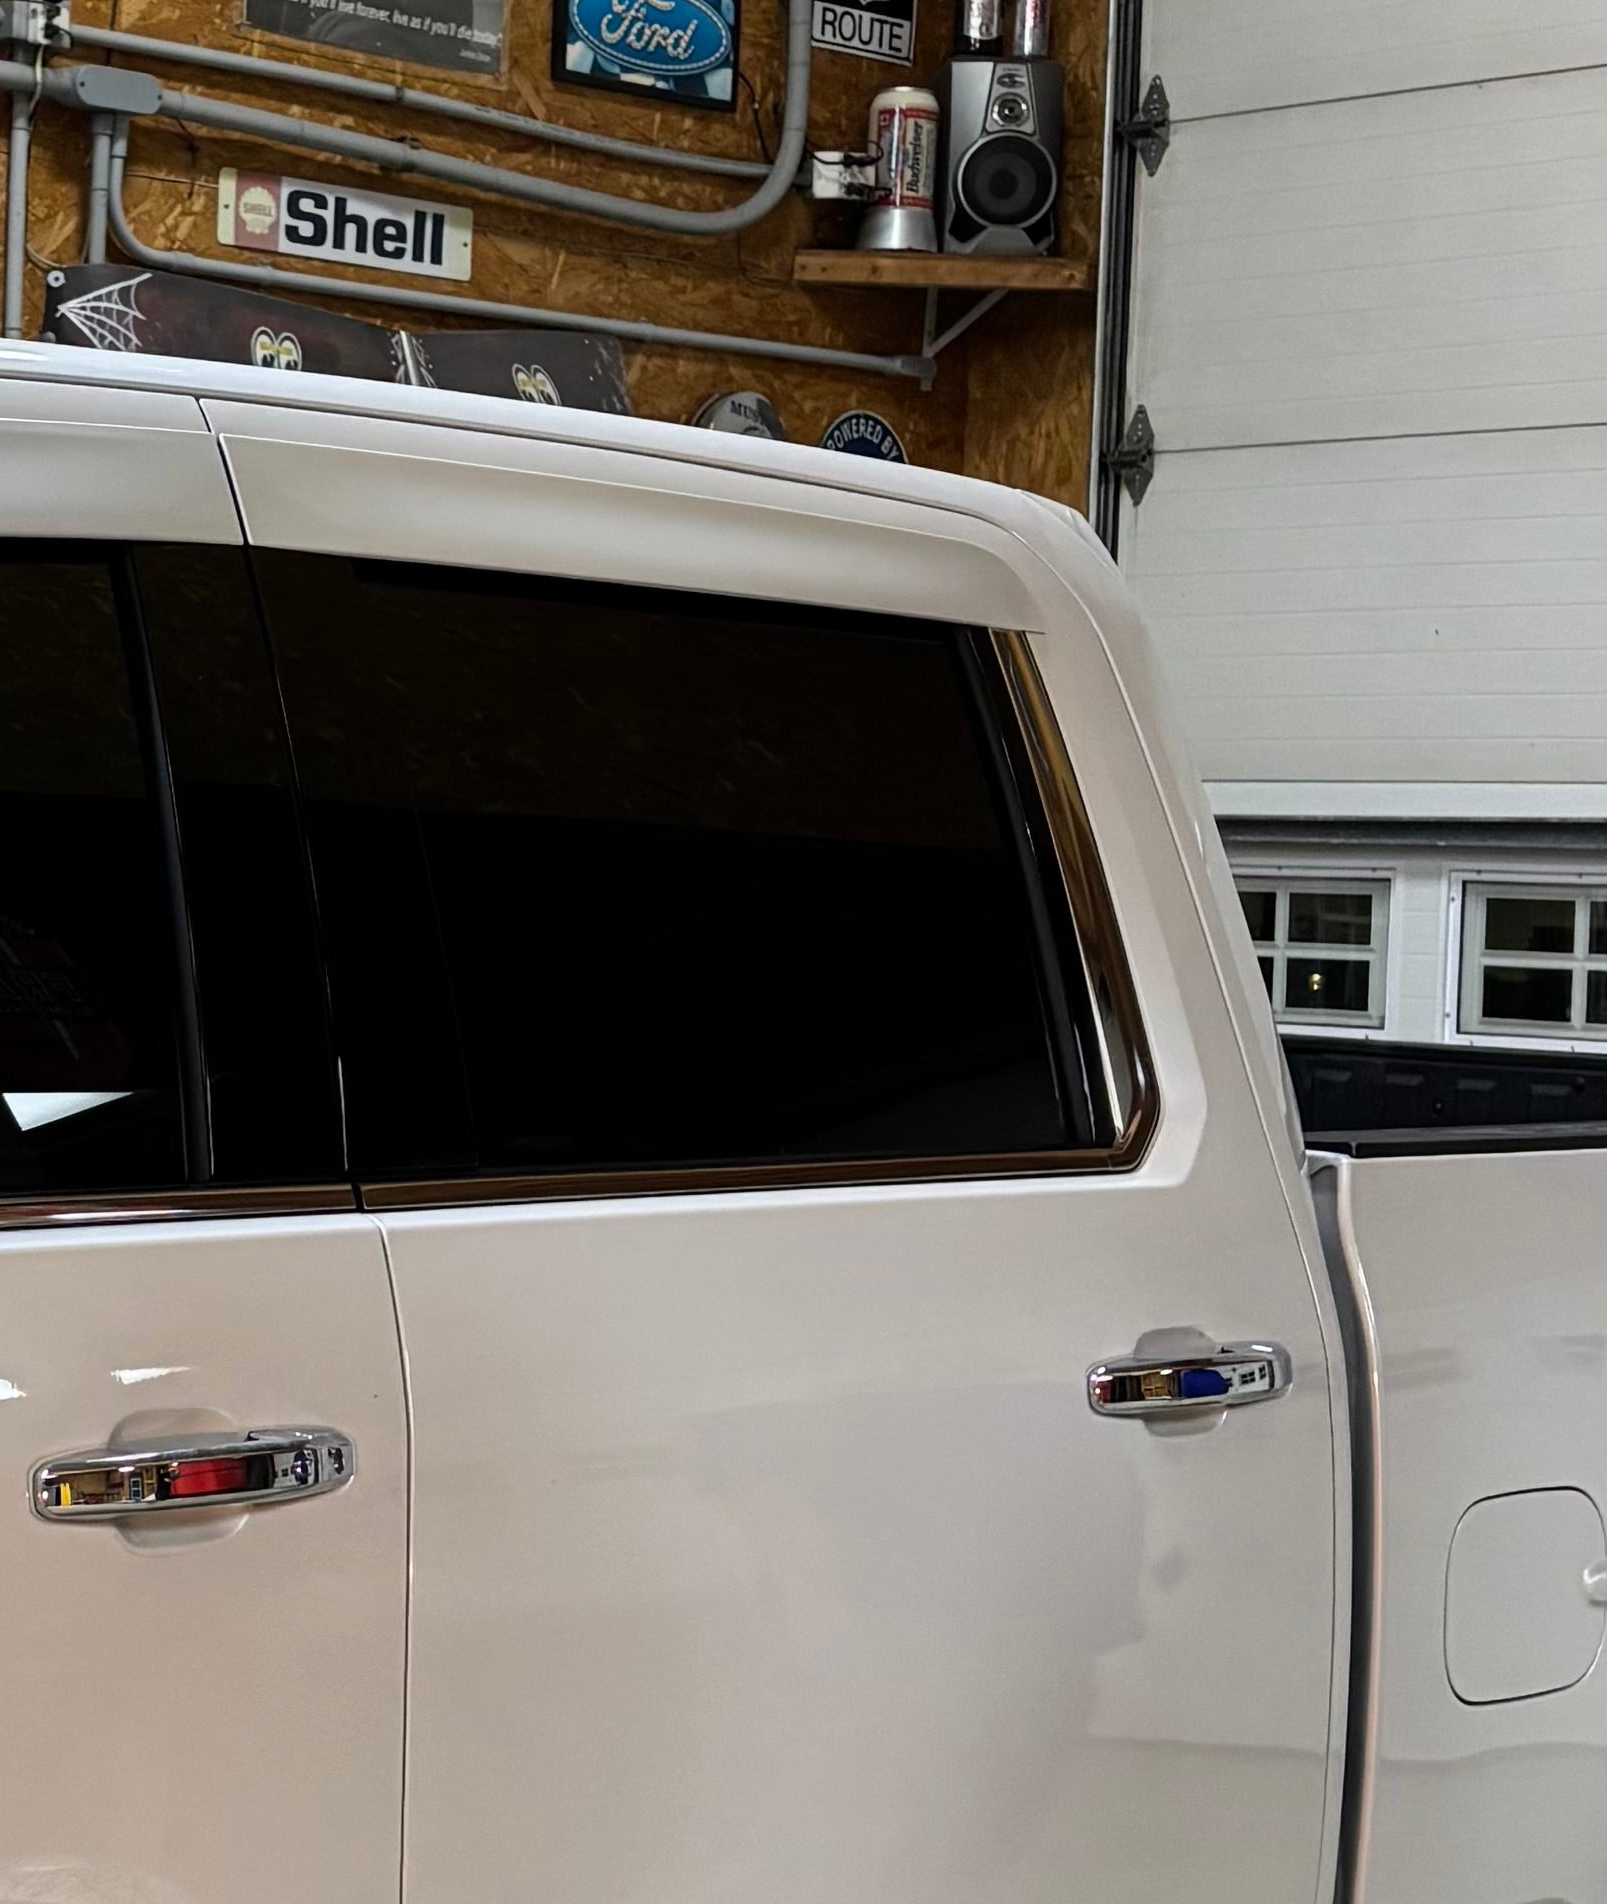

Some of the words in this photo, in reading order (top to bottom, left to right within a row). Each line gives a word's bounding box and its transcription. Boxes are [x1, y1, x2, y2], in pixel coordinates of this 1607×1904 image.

[821, 6, 905, 54] ROUTE
[285, 190, 445, 265] Shell
[826, 418, 882, 452] POWERED
